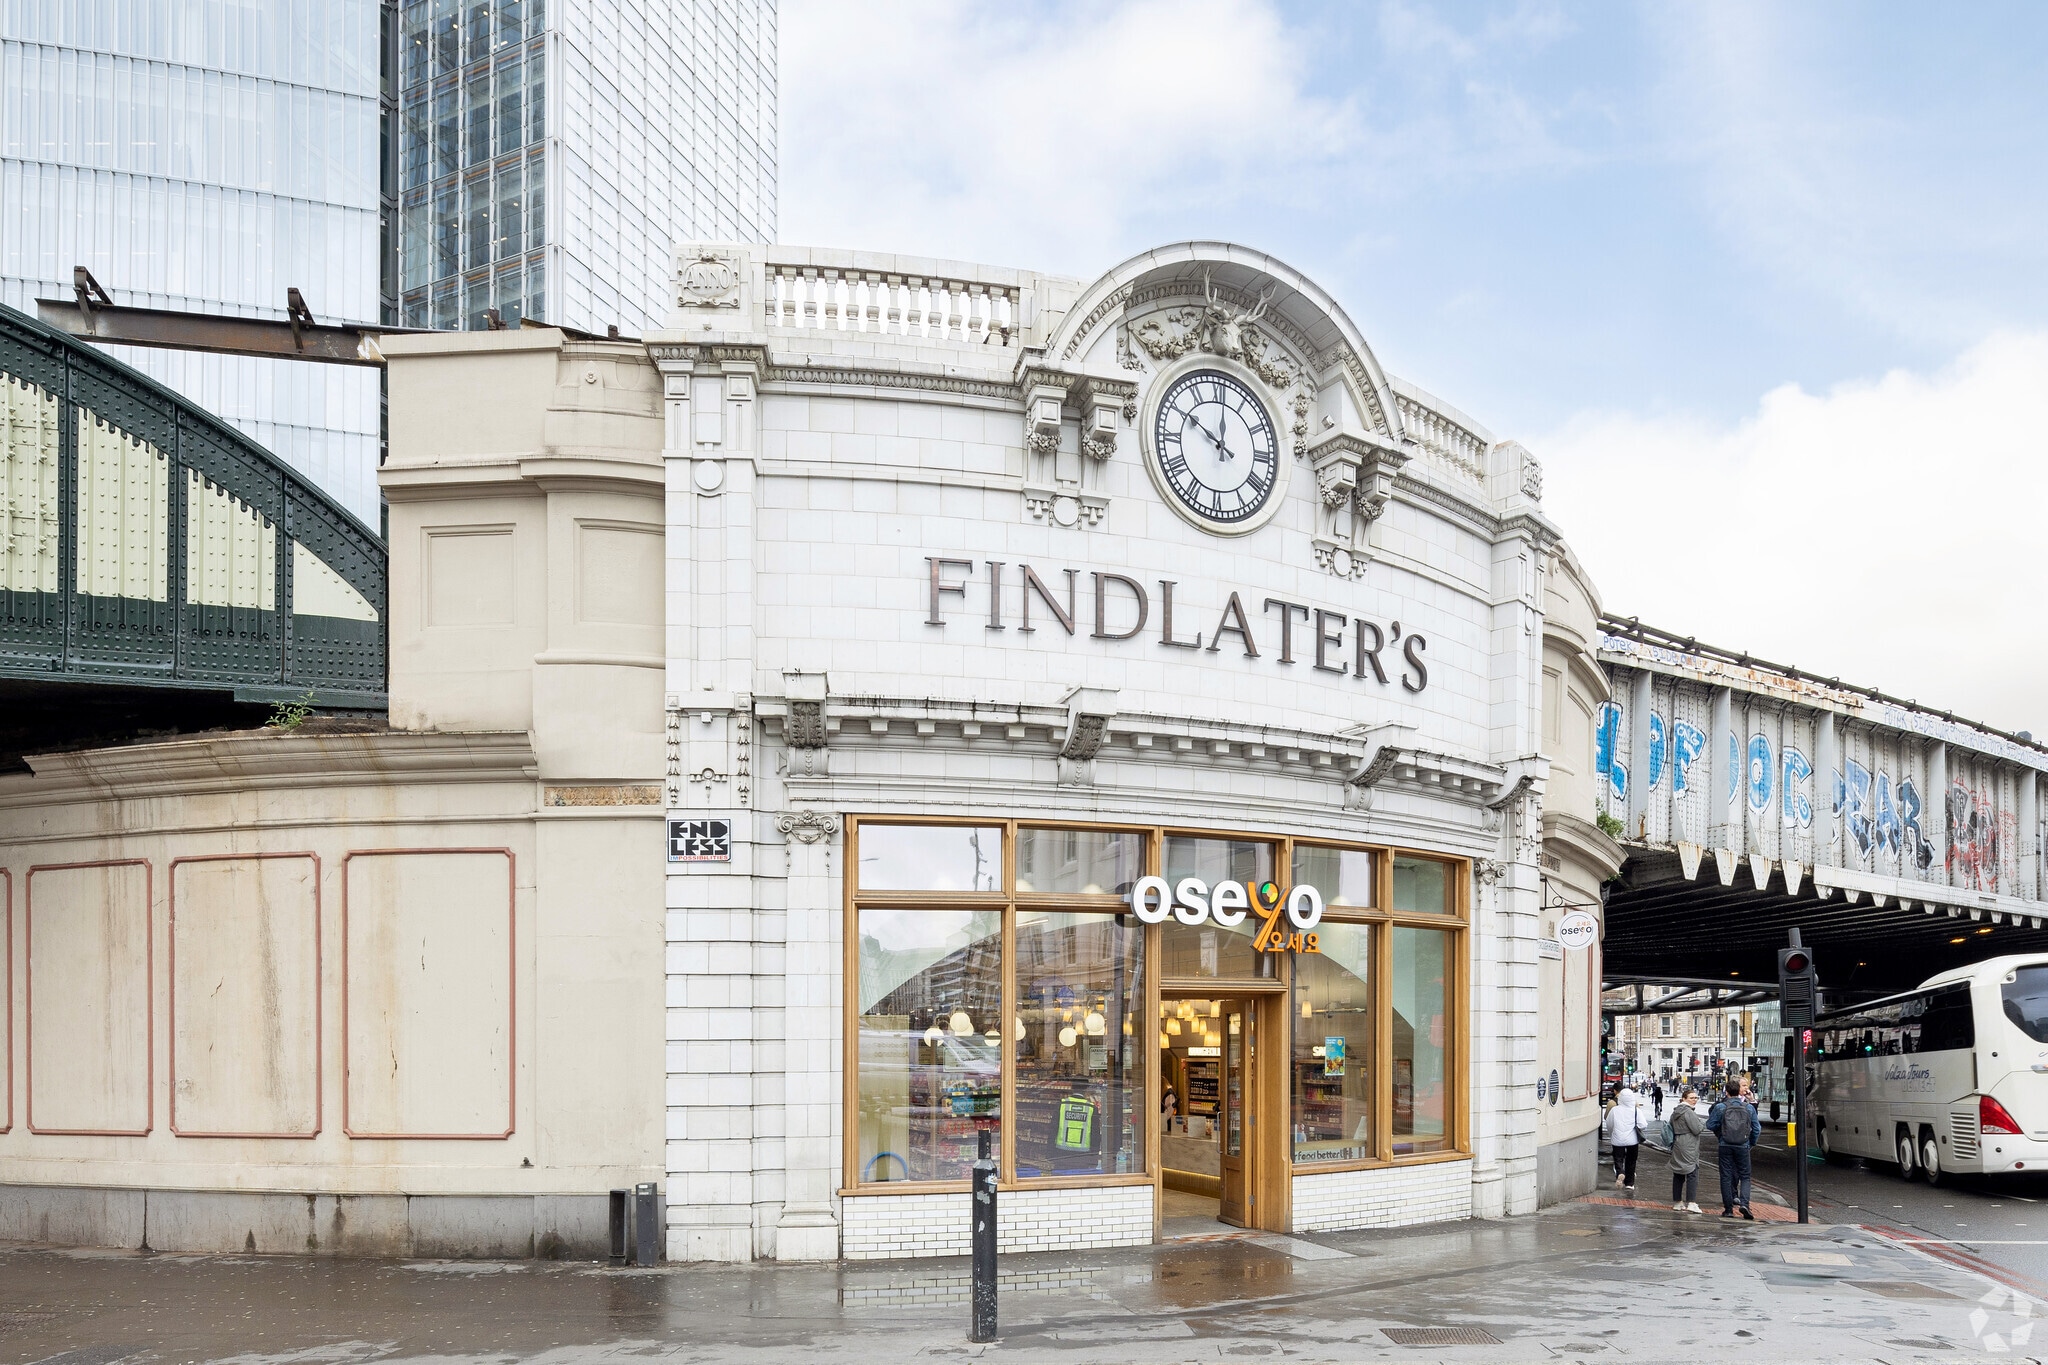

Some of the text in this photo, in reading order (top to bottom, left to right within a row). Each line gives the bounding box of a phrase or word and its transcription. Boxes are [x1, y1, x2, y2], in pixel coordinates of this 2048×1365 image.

[924, 556, 1428, 693] FINDLATER'S
[671, 821, 728, 838] END
[671, 839, 728, 855] LESS
[1131, 875, 1322, 953] oseyo
[1561, 926, 1592, 936] oseyo
[1267, 931, 1322, 954] 오세요
[1907, 1063, 1930, 1079] Tours
[1066, 1111, 1087, 1121] SECURITY
